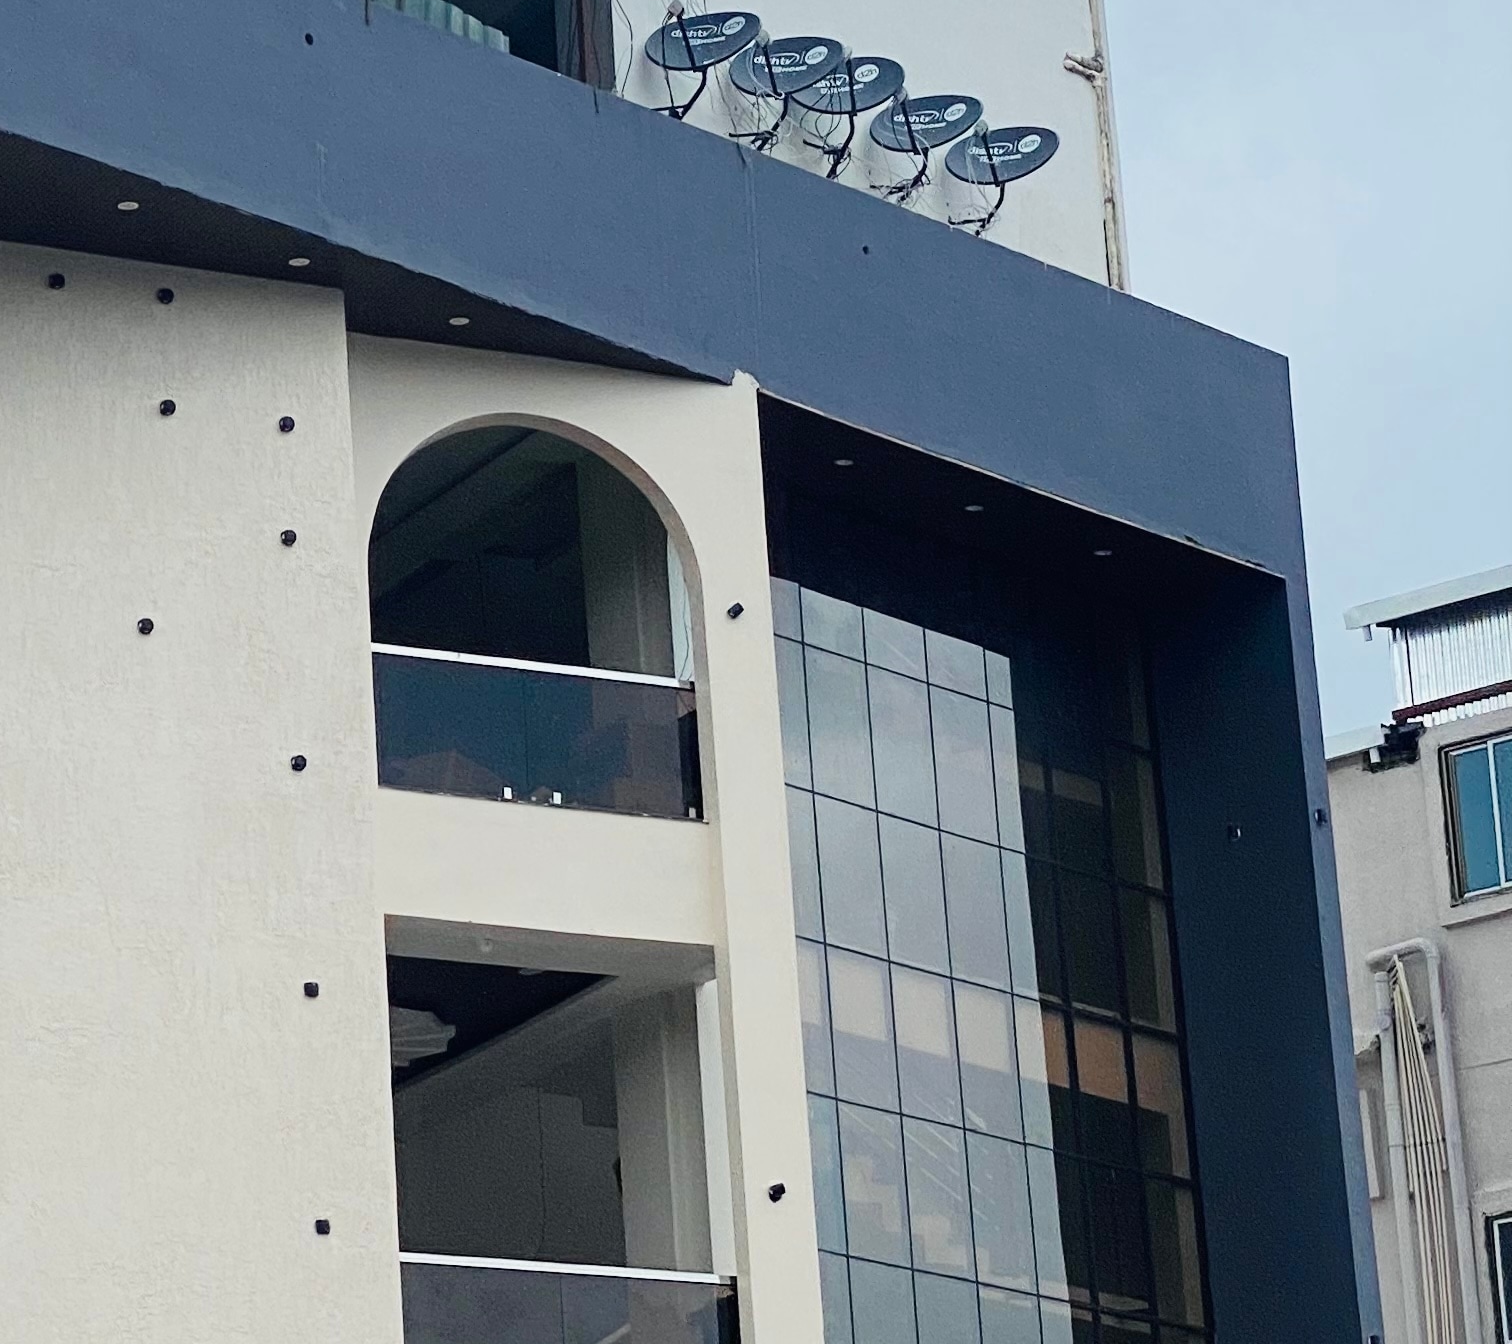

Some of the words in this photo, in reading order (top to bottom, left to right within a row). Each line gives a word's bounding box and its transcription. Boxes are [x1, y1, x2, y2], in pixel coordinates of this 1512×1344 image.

[671, 25, 717, 37] dihtv
[754, 54, 799, 66] dihtv
[893, 112, 935, 123] dihtv
